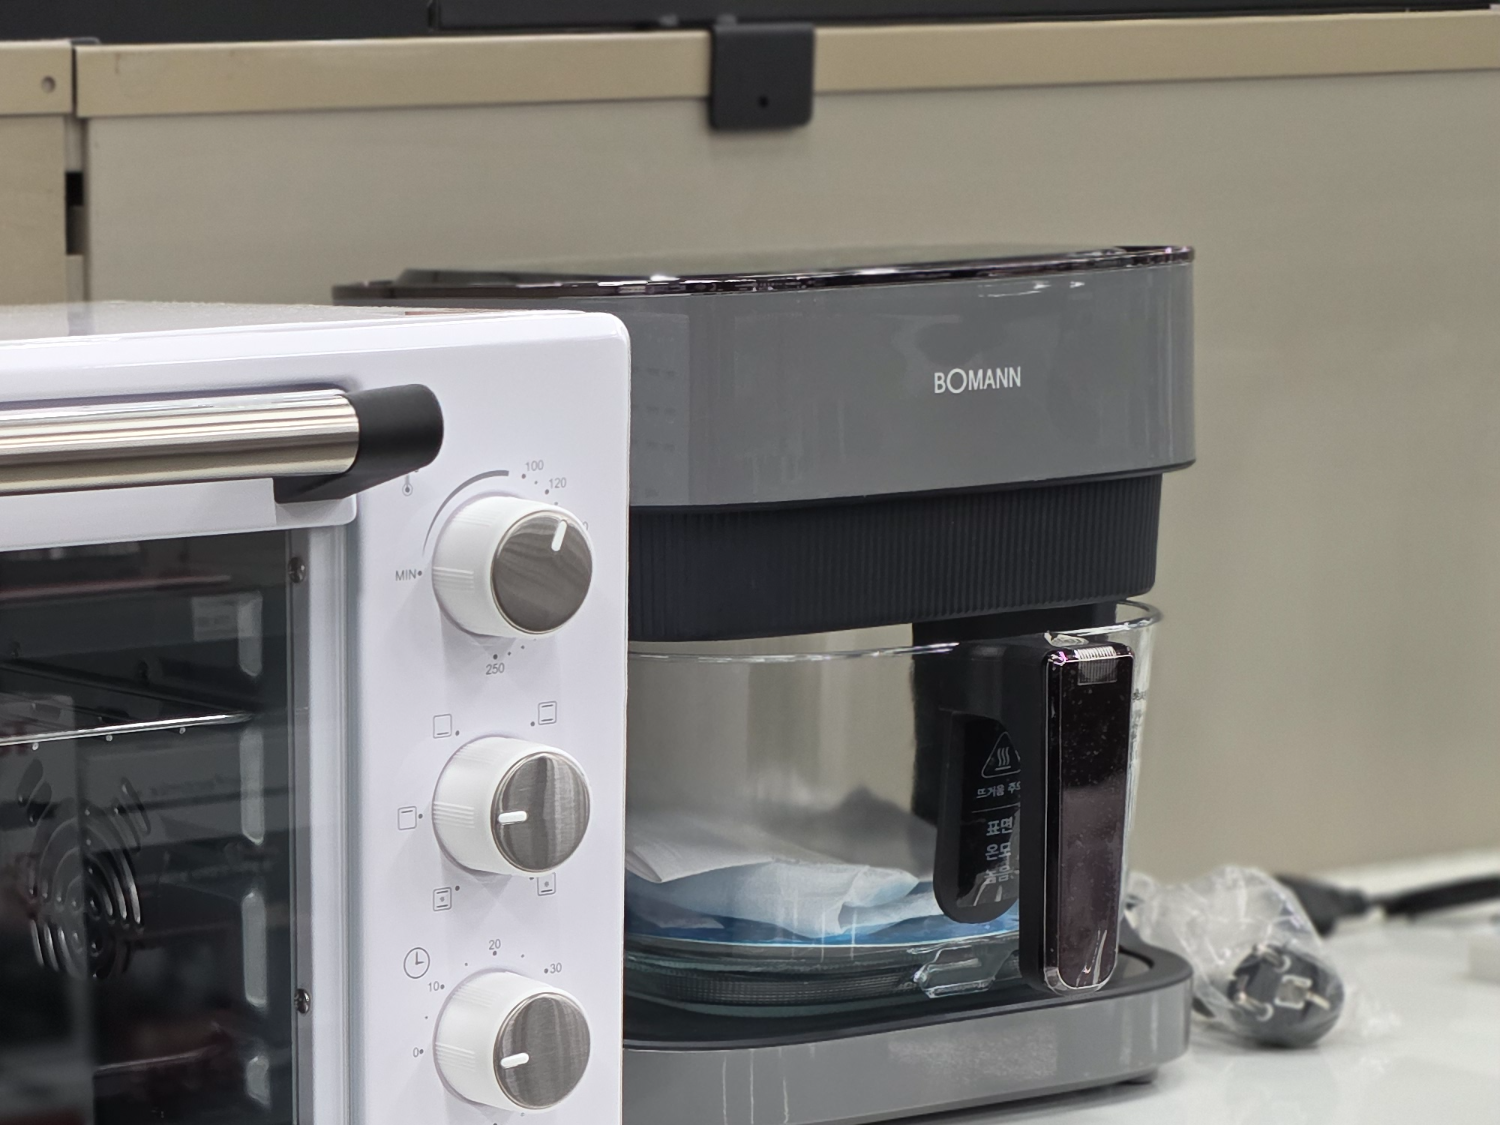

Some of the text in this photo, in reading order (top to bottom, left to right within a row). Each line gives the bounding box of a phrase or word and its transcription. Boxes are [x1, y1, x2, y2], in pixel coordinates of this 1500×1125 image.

[933, 365, 1022, 394] BOMANN
[525, 459, 544, 472] 100
[549, 477, 567, 489] 120
[395, 568, 417, 581] MIN
[485, 662, 505, 676] 250
[976, 784, 1005, 799] 뜨거움
[986, 816, 1013, 836] 표면
[488, 938, 501, 950] 20
[549, 962, 562, 974] 30
[428, 981, 440, 992] 10
[412, 1047, 419, 1058] 0
